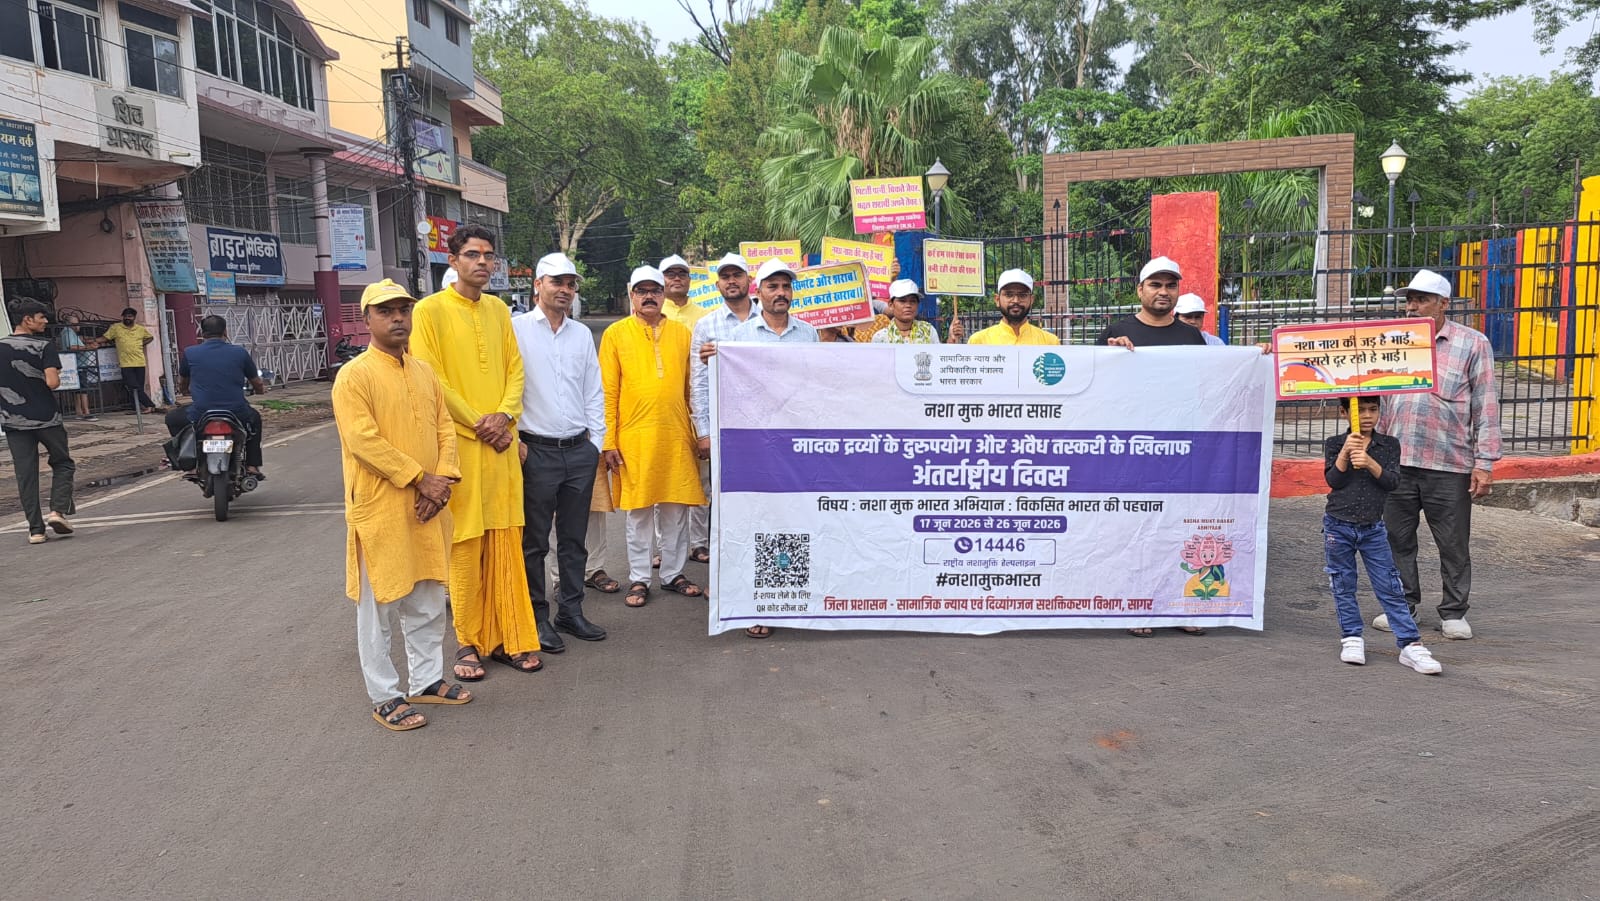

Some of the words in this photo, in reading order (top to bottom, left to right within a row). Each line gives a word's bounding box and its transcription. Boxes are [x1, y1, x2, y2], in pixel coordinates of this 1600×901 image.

[111, 95, 144, 126] शिव
[18, 133, 34, 148] वर्क
[208, 233, 246, 261] ब्राइट
[246, 236, 278, 258] मेडिको
[816, 273, 832, 287] और
[813, 290, 832, 304] करते
[1293, 340, 1315, 351] नशा
[1318, 339, 1339, 349] नाश
[1343, 335, 1356, 348] की
[1360, 337, 1377, 349] जड़
[1379, 333, 1387, 346] है
[939, 354, 971, 363] सामाजिक
[974, 355, 990, 363] न्याय
[993, 353, 1006, 363] और
[1303, 353, 1330, 367] इससे
[1333, 354, 1347, 367] दूर
[1350, 351, 1367, 364] रहो
[1381, 348, 1401, 362] भाई
[939, 366, 977, 375] अधिकारिता
[979, 366, 1003, 375] मंत्रालय
[939, 378, 957, 386] भारत
[960, 378, 983, 386] सरकार
[924, 403, 955, 418] नशा
[957, 403, 985, 423] मुक्त
[987, 403, 1023, 419] भारत
[1026, 403, 1063, 419] सप्ताह
[792, 437, 841, 454] मादक
[843, 433, 882, 455] द्रव्यों
[883, 433, 900, 454] के
[902, 434, 972, 459] दुरुपयोग
[976, 434, 1007, 454] और
[1010, 434, 1050, 455] अवैध
[1051, 435, 1106, 456] तस्करी
[1109, 435, 1126, 455] के
[1128, 435, 1192, 456] खिलाफ
[912, 459, 1008, 490] अंतर्राष्ट्रीय
[1012, 459, 1070, 487] दिवस
[817, 496, 849, 512] विषय
[859, 499, 886, 512] नशा
[889, 499, 914, 514] मुक्त
[917, 499, 950, 512] भारत
[953, 496, 1005, 512] अभियान
[1016, 496, 1065, 513] विकसित
[1068, 500, 1100, 512] भारत
[1103, 497, 1119, 512] की
[1123, 500, 1164, 513] पहचान
[919, 519, 930, 529] 17
[933, 519, 951, 532] जून
[953, 519, 981, 529] 2026
[983, 516, 994, 529] से
[996, 519, 1010, 529] 26
[1012, 519, 1031, 532] जून
[1033, 519, 1061, 529] 2026
[974, 537, 1026, 552] 14446
[943, 557, 964, 567] राष्ट्रीय
[966, 557, 998, 569] नशामुक्ति
[1001, 557, 1036, 568] हेल्पलाइन
[936, 572, 1042, 591] #नशामुक्तभारत
[753, 590, 776, 600] ई-शपथ
[777, 590, 790, 600] लेने
[790, 590, 798, 600] के
[798, 590, 811, 600] लिए
[756, 604, 766, 613] QR
[767, 603, 779, 612] कोड
[780, 603, 796, 612] स्कैन
[824, 596, 849, 611] जिला
[850, 598, 888, 611] प्रशासन
[896, 596, 941, 611] सामाजिक
[944, 598, 968, 611] न्याय
[970, 597, 984, 610] एवं
[985, 596, 1033, 611] दिव्यांगजन
[1036, 596, 1091, 611] सशक्तिकरण
[1093, 596, 1125, 612] विभाग,
[1127, 598, 1154, 611] सागर
